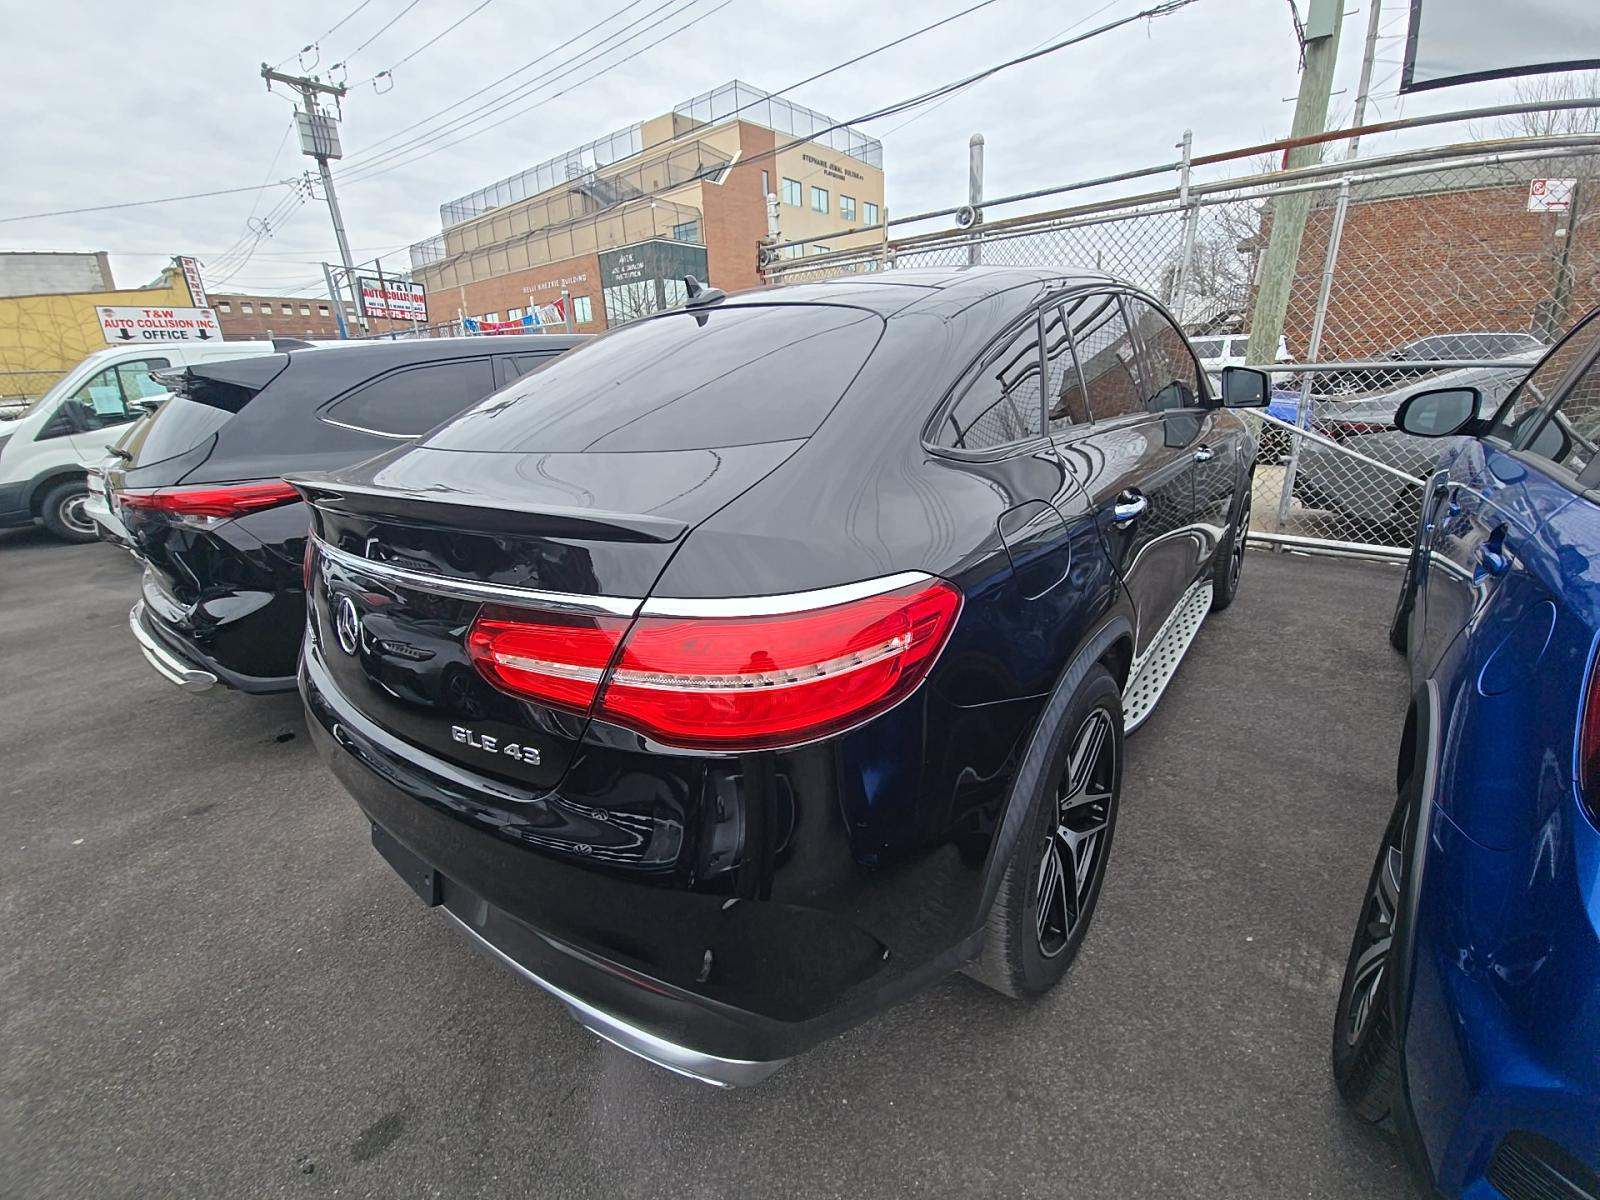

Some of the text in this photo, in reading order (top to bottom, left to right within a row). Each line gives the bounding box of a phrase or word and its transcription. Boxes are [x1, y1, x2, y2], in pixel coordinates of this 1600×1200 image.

[802, 154, 827, 168] STEPHANIE
[143, 309, 174, 318] T&W
[104, 319, 218, 329] AUTO COLLISION INC.
[142, 329, 189, 340] OFFICE
[451, 725, 541, 766] GLE 43
